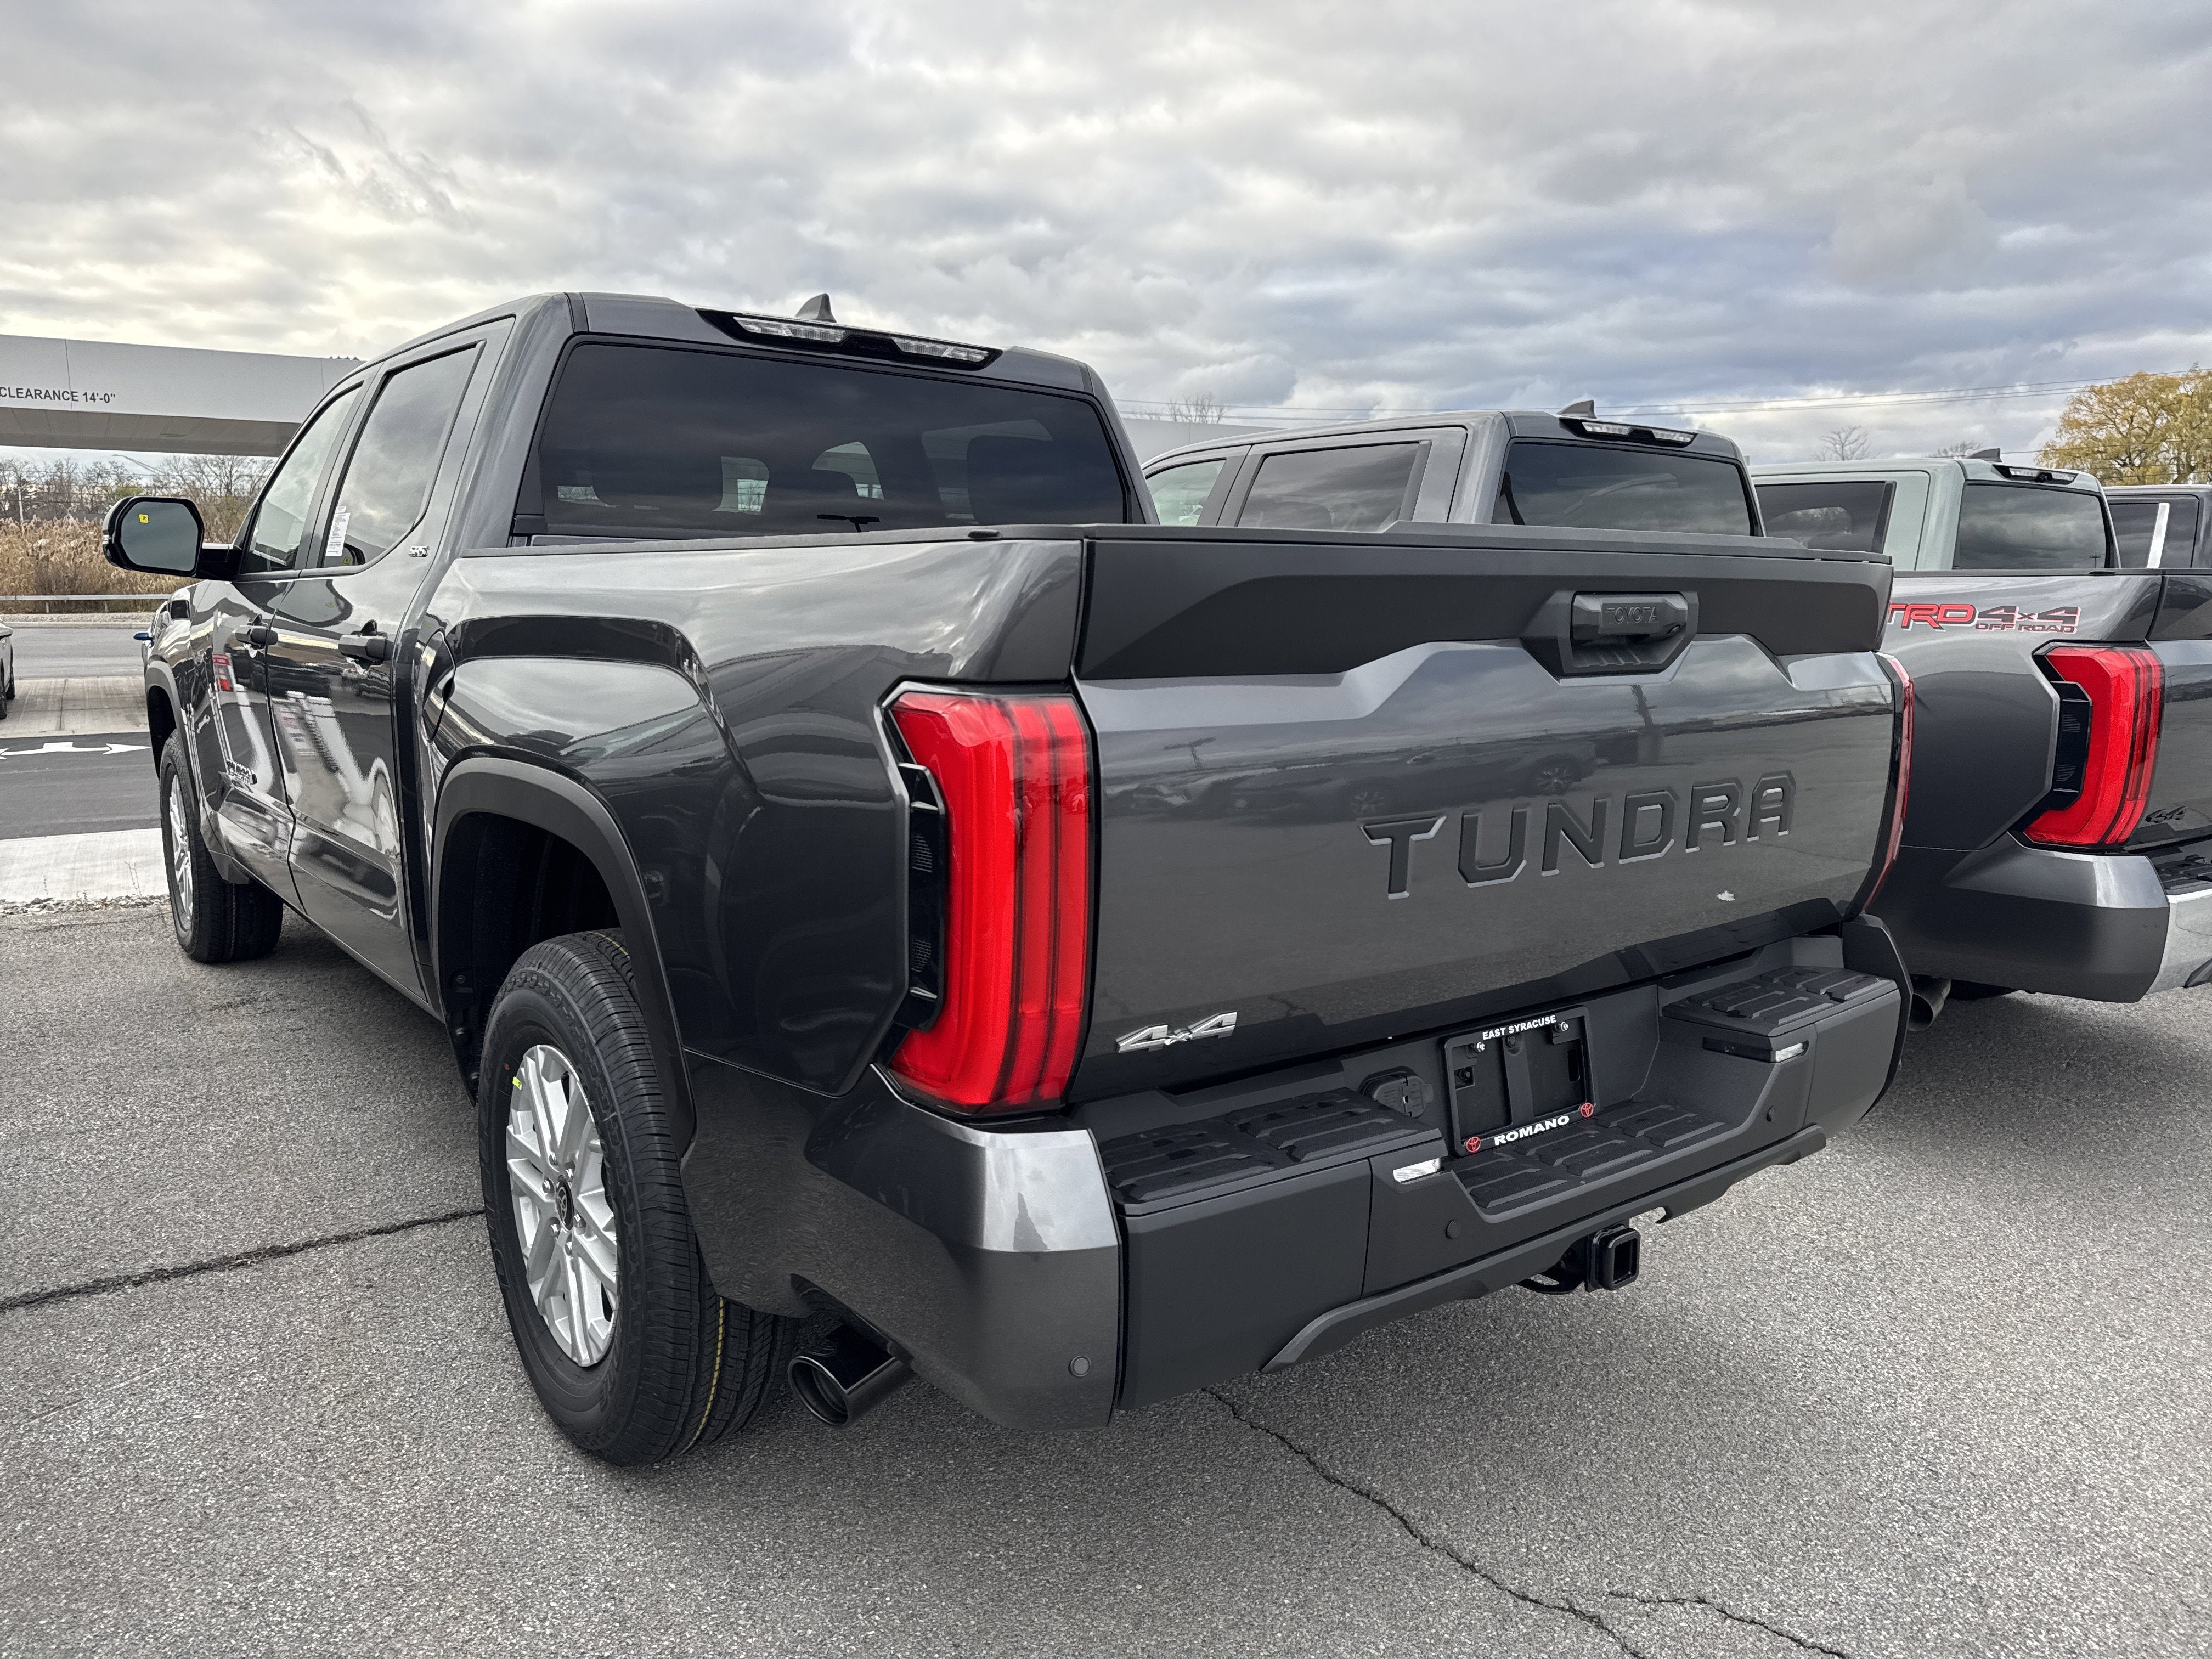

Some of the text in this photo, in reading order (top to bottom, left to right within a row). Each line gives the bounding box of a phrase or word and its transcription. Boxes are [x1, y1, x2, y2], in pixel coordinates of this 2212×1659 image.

[0, 387, 116, 403] CLEARANCE 14'-0"
[1607, 606, 1658, 624] TOYOTA
[1887, 604, 1977, 631] TRD
[1975, 623, 2078, 634] OFF ROAD
[1358, 770, 1796, 900] TUNDRA
[1482, 1015, 1556, 1040] EAST SYRACUSE
[1494, 1115, 1570, 1146] ROMANO
